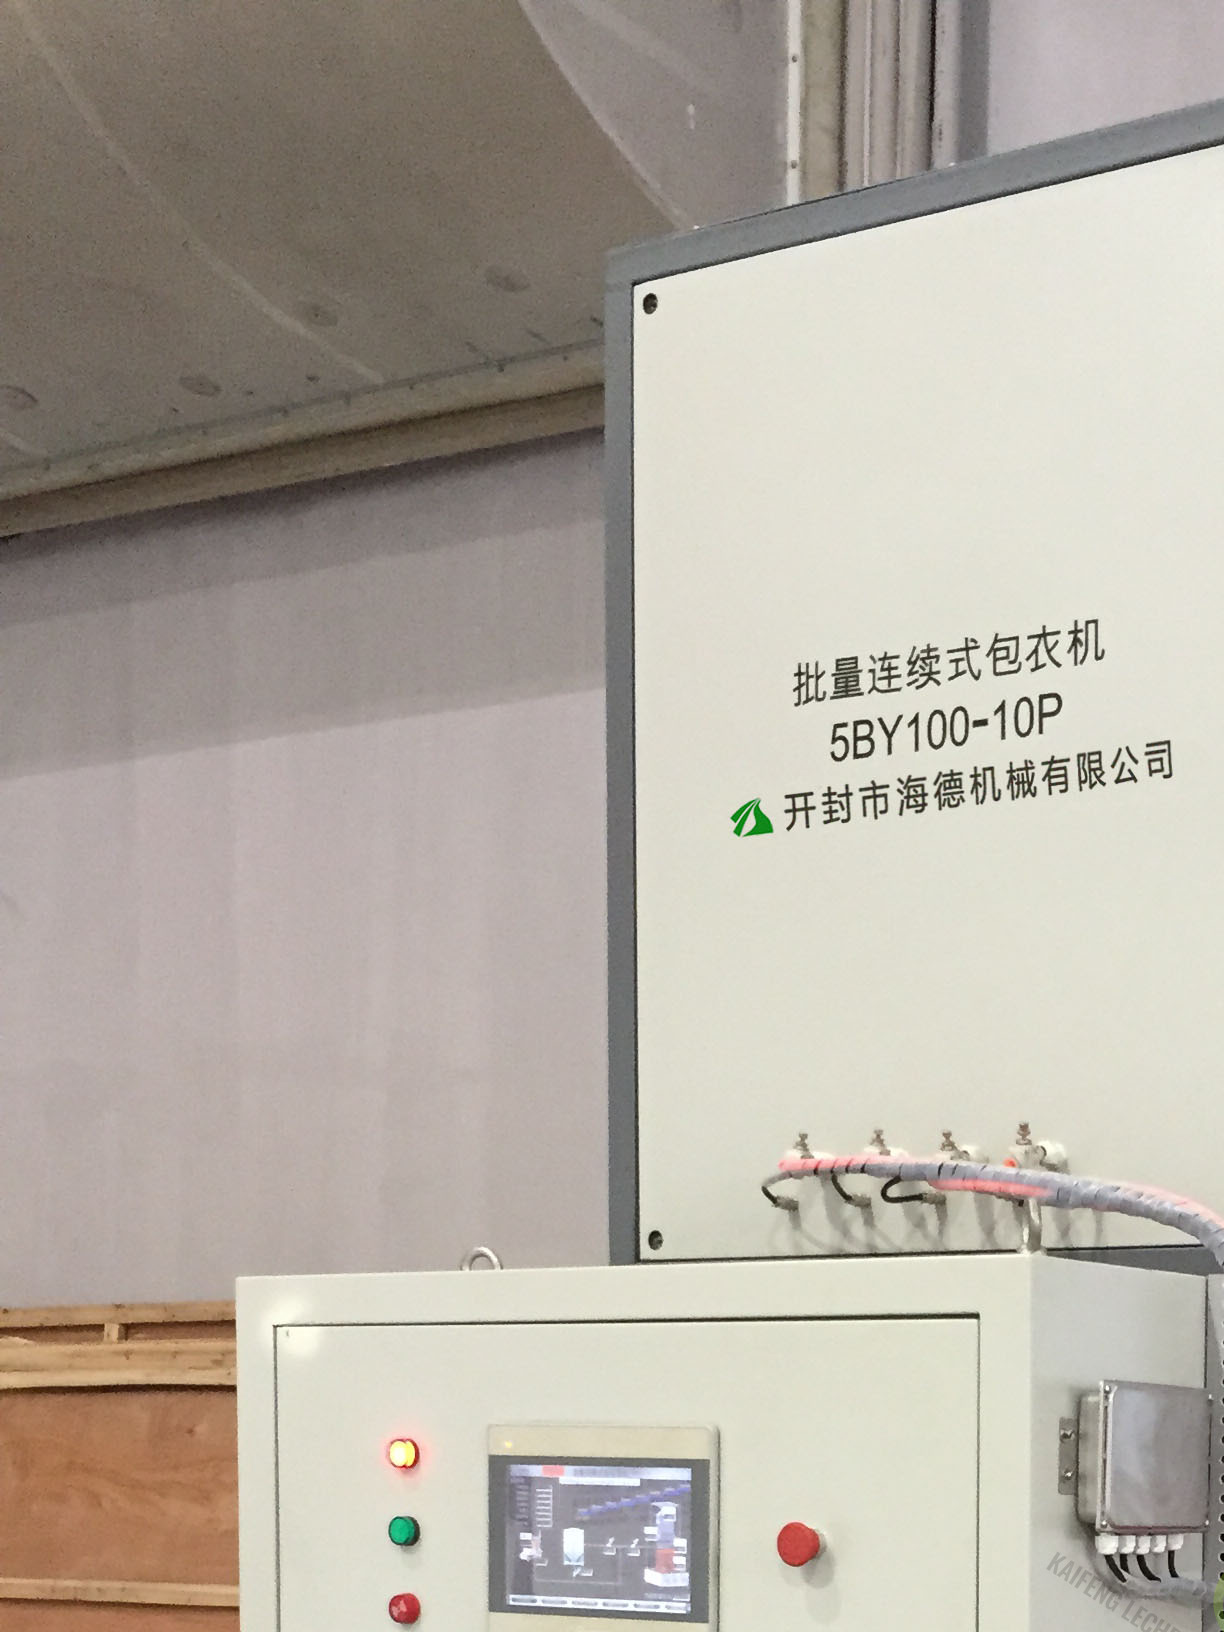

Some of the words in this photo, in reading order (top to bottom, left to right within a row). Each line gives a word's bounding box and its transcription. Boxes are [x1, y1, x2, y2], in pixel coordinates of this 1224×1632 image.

[793, 619, 1105, 707] 批量连续式包衣机
[830, 693, 1062, 762] 5BY100-10P
[784, 740, 1173, 831] 开封市海德机械有限公司
